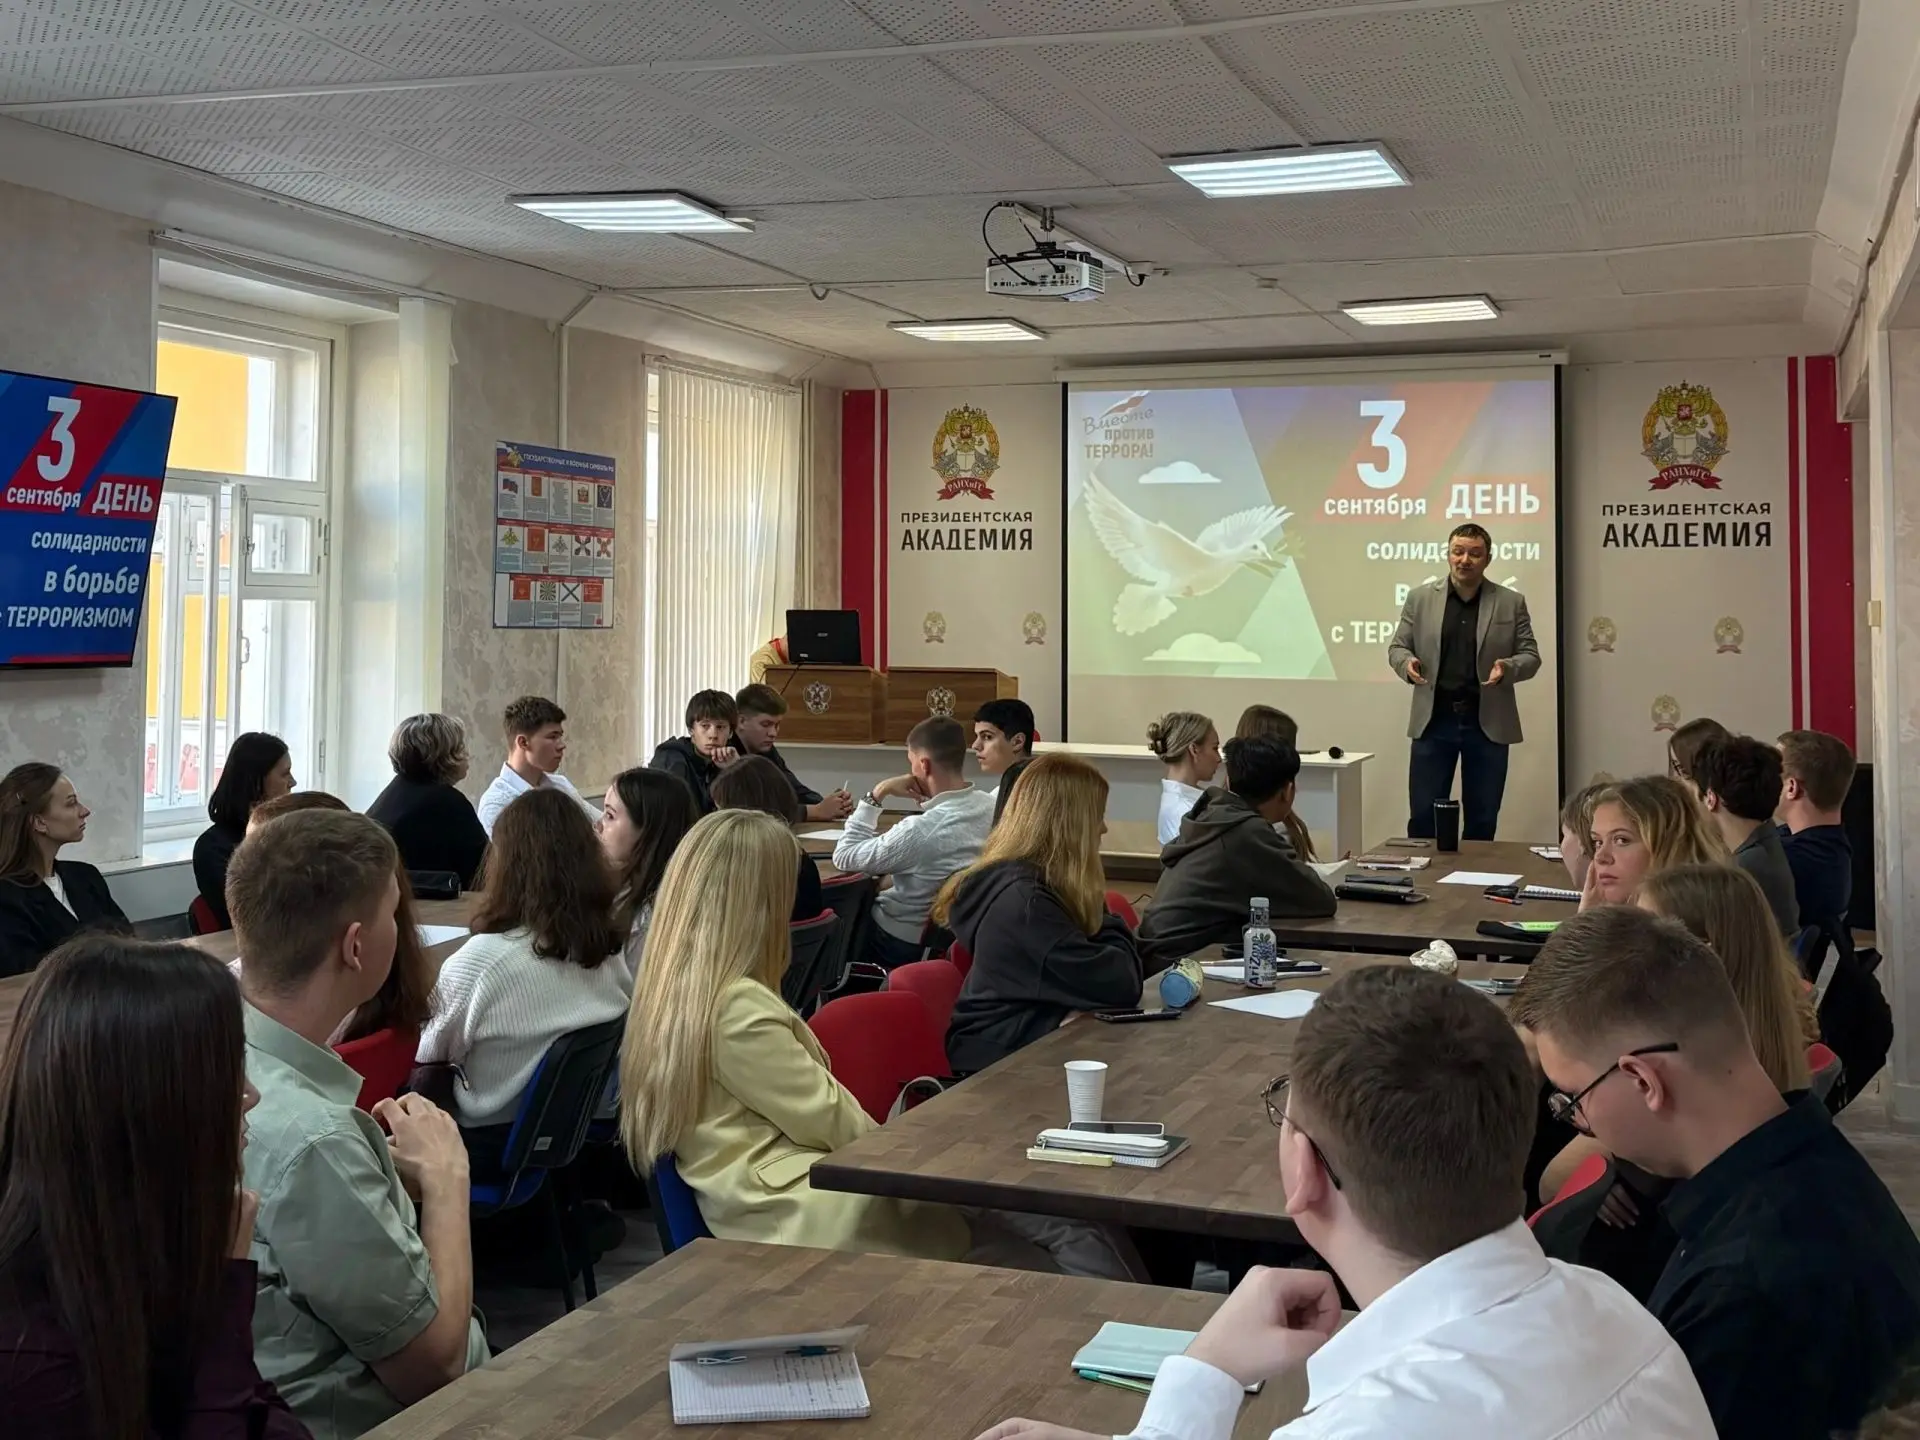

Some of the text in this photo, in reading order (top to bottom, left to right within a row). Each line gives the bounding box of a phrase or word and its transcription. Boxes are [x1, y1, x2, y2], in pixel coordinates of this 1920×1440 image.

[1082, 407, 1154, 435] Вместе
[37, 396, 81, 482] 3
[1104, 429, 1154, 443] против
[1357, 400, 1407, 489] 3
[1084, 444, 1153, 459] ТЕРРОРА!
[1661, 466, 1710, 481] РАНХиГС
[7, 482, 153, 515] сентября ДЕНЬ
[1324, 483, 1540, 519] сентября ДЕНЬ
[1602, 502, 1771, 516] ПРЕЗИДЕНТСКАЯ
[901, 511, 1033, 523] ПРЕЗИДЕНТСКАЯ
[31, 531, 147, 555] солидарности
[901, 528, 1033, 551] АКАДЕМИЯ
[1602, 521, 1772, 548] АКАДЕМИЯ
[44, 564, 139, 599] в борьбе
[7, 606, 135, 628] ТЕРРОРИЗМОМ
[1331, 626, 1344, 643] с
